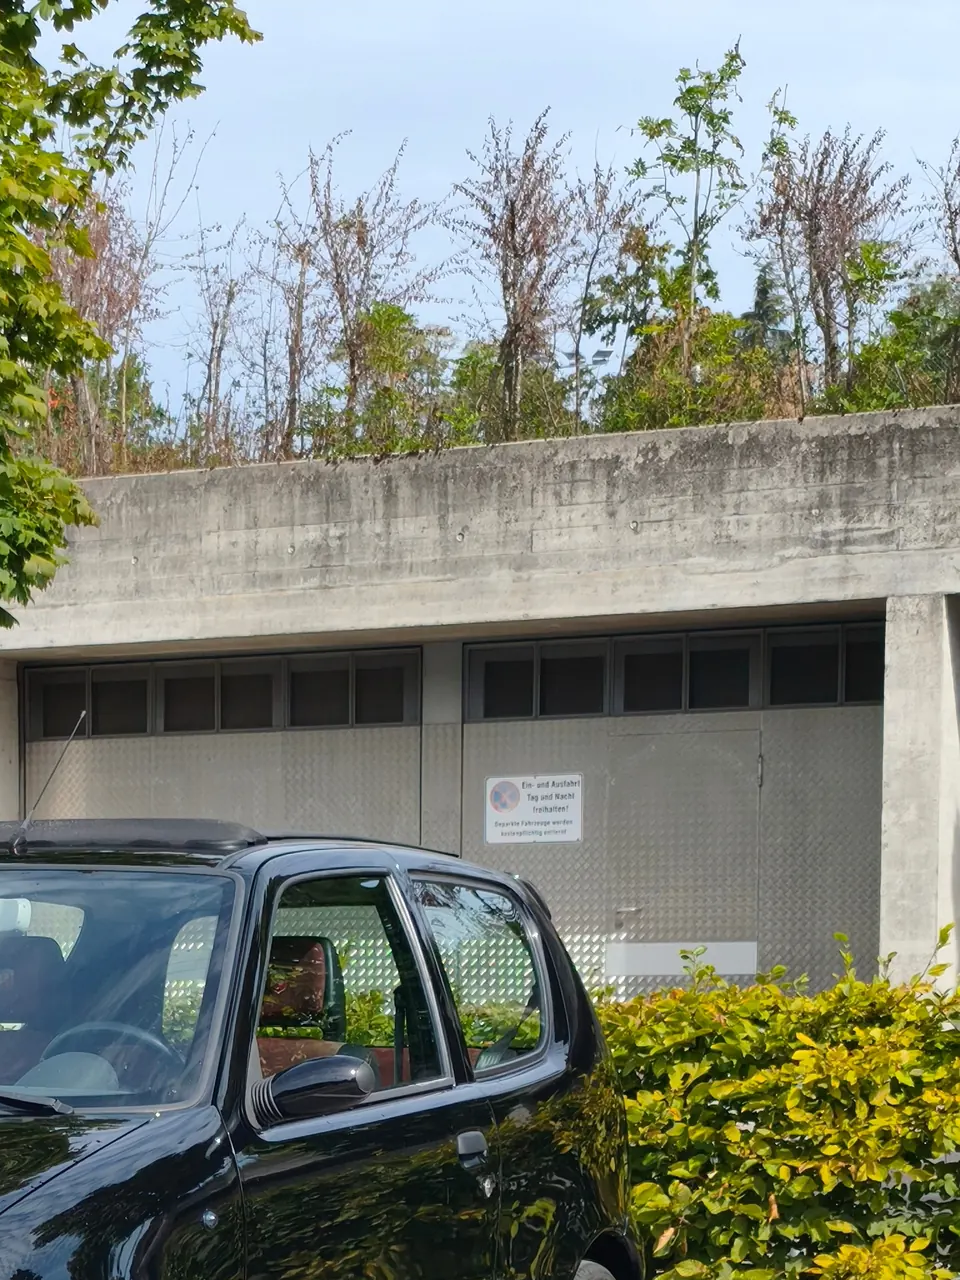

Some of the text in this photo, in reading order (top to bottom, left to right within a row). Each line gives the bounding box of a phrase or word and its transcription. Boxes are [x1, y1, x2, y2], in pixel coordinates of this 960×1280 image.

[522, 781, 535, 789] Ein-
[551, 780, 580, 788] Ausfahrt
[527, 794, 539, 802] Tag
[533, 805, 569, 813] freihalten!
